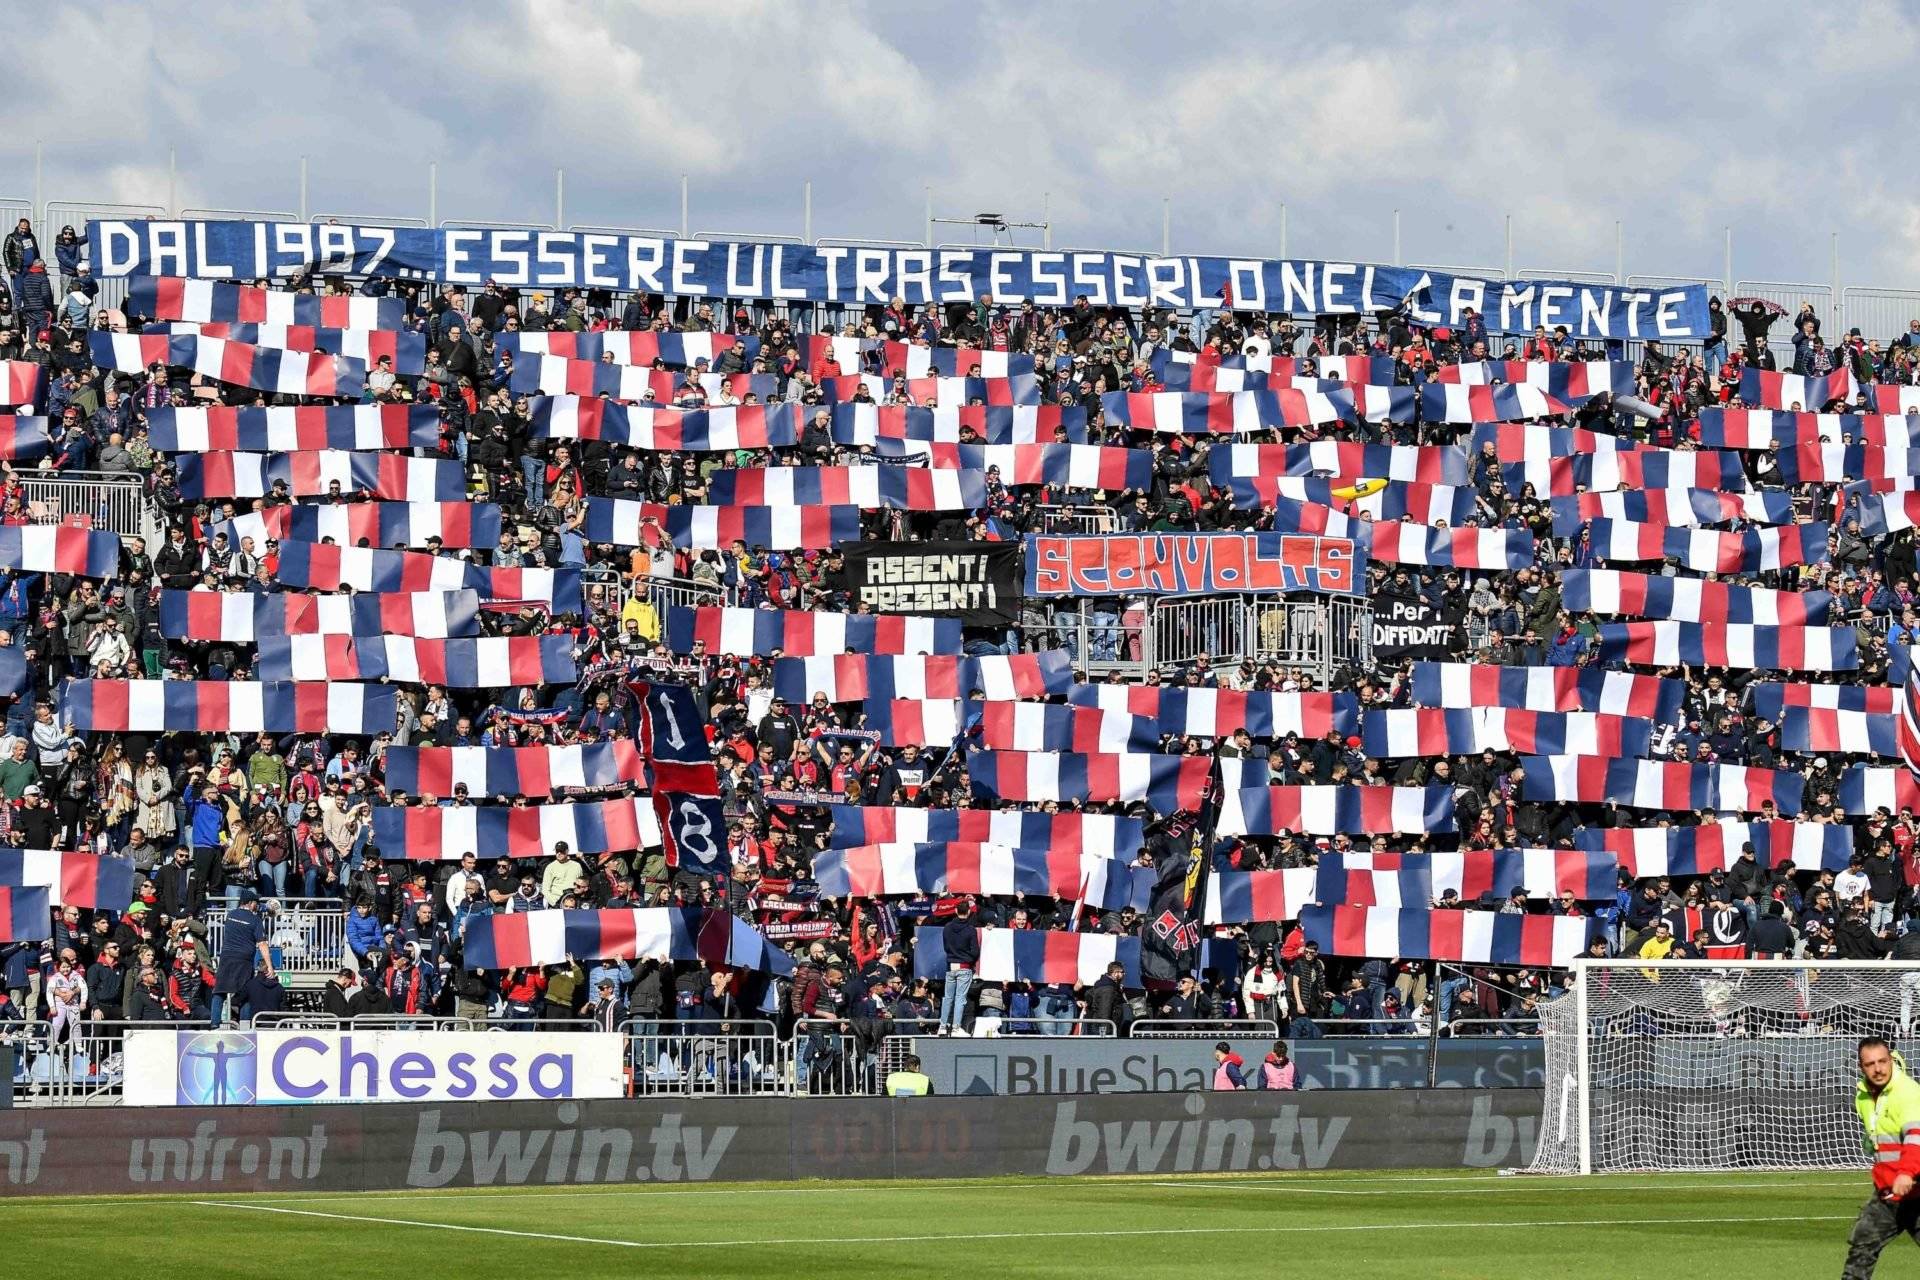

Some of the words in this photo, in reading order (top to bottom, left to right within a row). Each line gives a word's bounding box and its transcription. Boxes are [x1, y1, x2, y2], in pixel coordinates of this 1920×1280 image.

[99, 221, 233, 277] DAL
[445, 230, 711, 295] ESSERE
[726, 243, 975, 304] ULTRAS
[989, 251, 1266, 307] ESSERLO
[1501, 284, 1694, 338] MENTE
[859, 583, 997, 612] PRESENTI
[765, 924, 791, 934] FORZA
[272, 1036, 573, 1098] Chessa
[129, 1120, 328, 1182] infront
[406, 1101, 739, 1188] bwin.tv
[1046, 1092, 1351, 1175] bwin.tv
